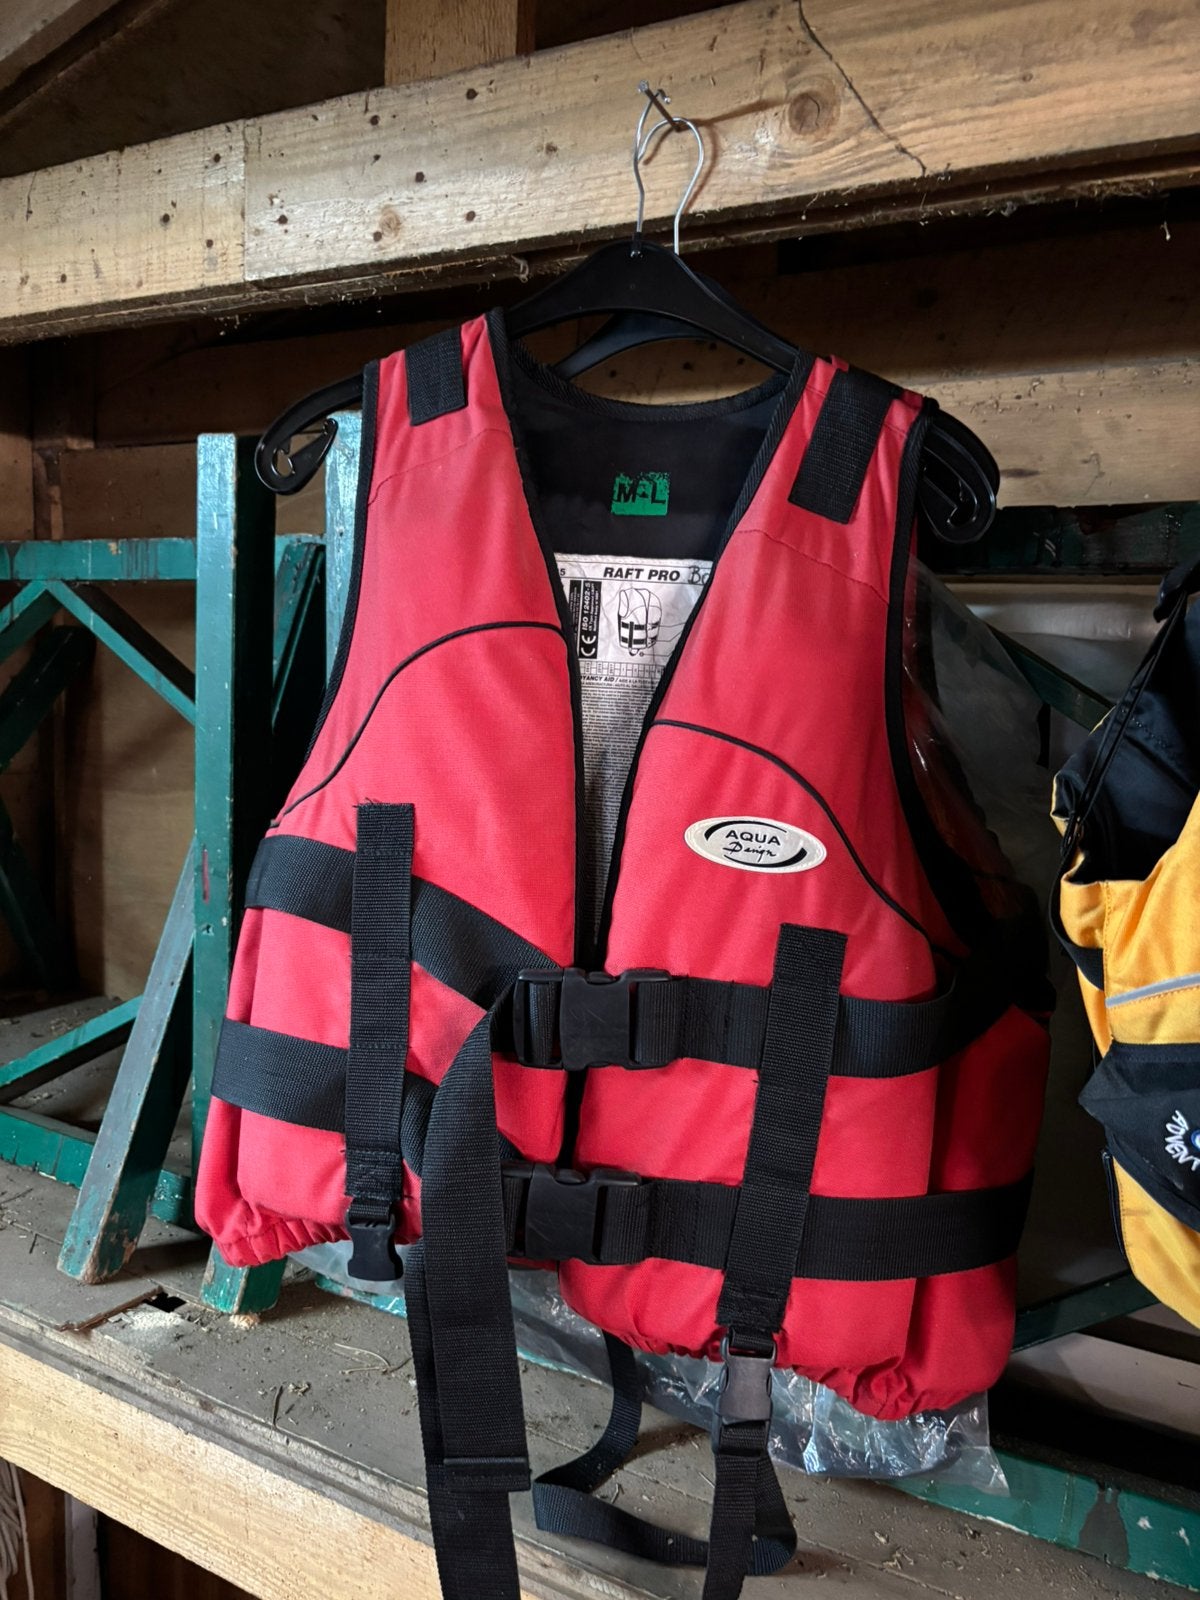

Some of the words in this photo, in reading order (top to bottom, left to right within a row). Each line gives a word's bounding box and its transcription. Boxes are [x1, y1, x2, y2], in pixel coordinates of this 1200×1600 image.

[603, 567, 643, 579] RAFT
[648, 569, 680, 582] PRO
[581, 616, 589, 631] ISO
[726, 830, 781, 846] AQUA
[723, 842, 777, 862] Design
